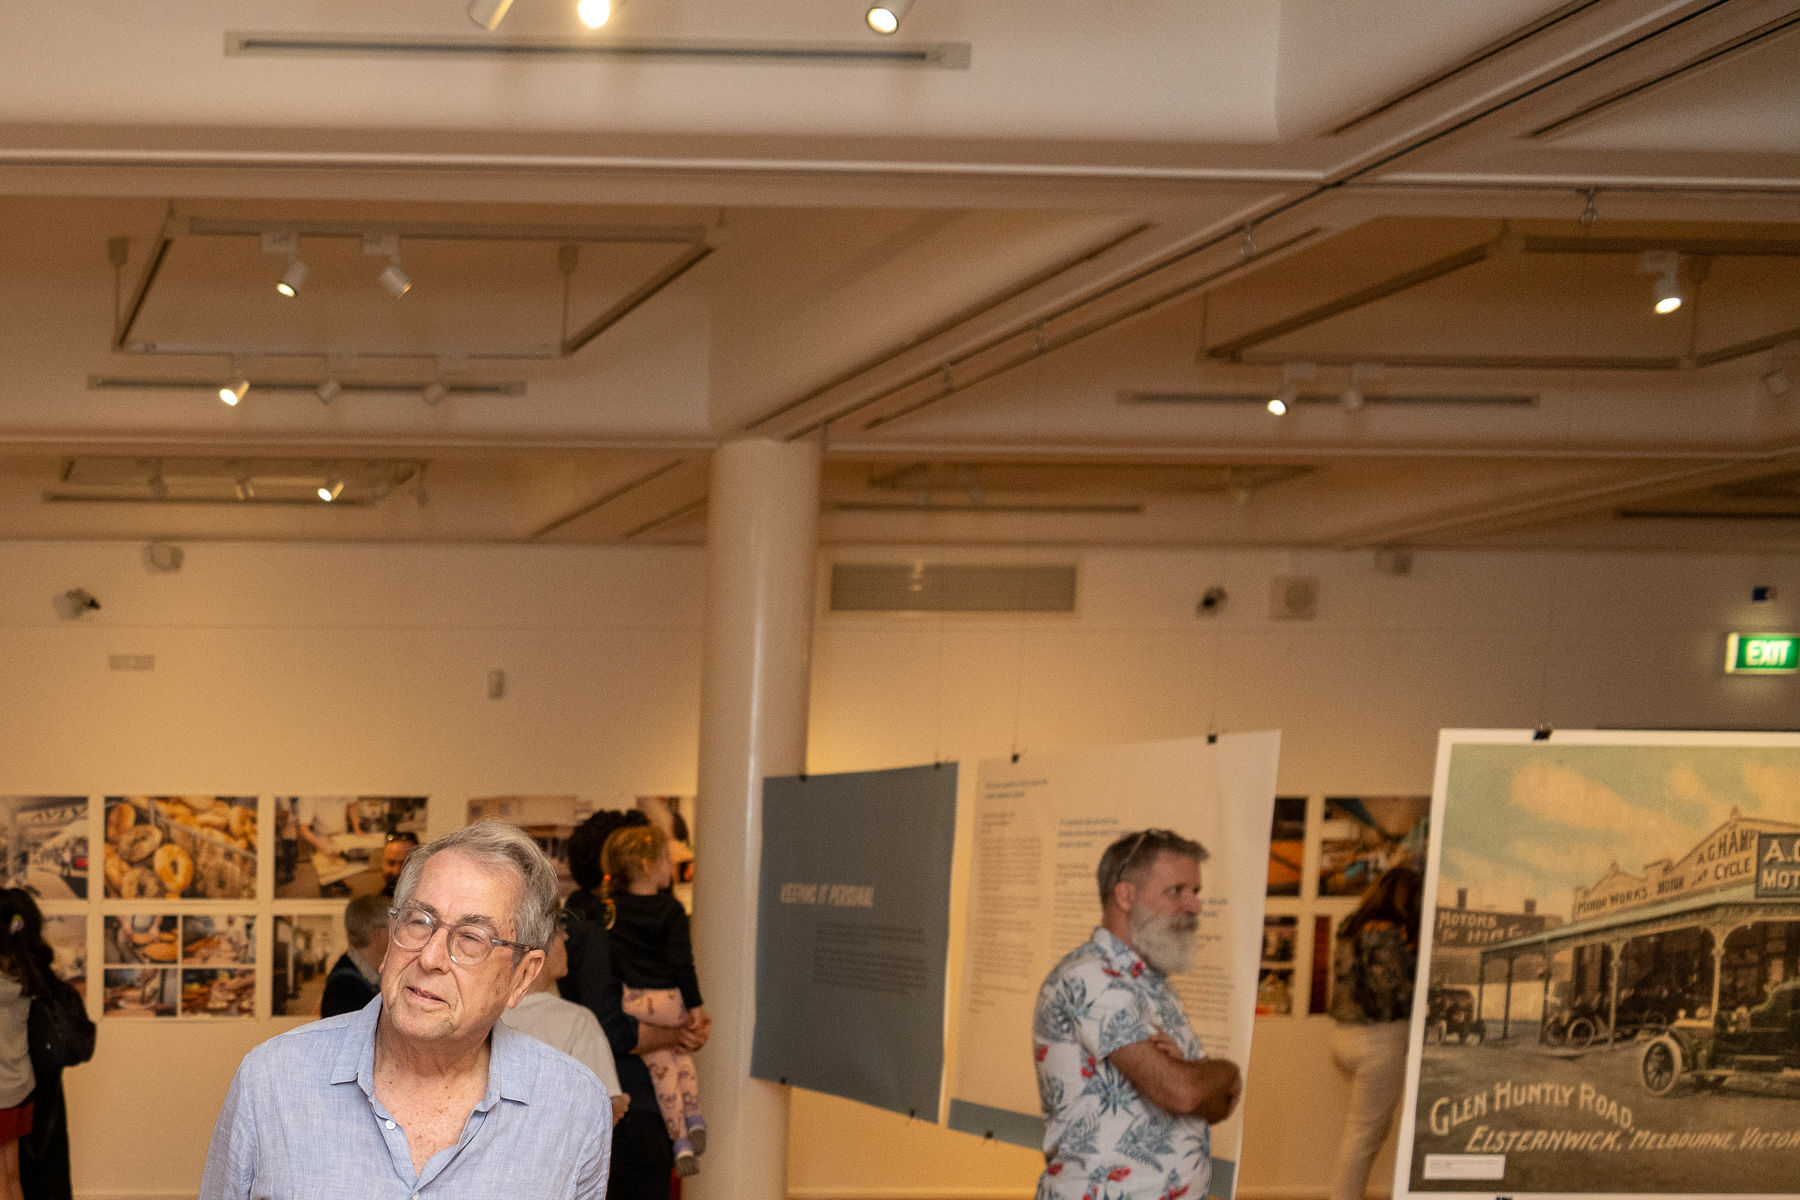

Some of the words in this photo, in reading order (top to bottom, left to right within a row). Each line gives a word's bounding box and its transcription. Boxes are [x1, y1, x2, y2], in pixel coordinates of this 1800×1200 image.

[1745, 639, 1792, 666] EXIT
[1430, 1096, 1488, 1136] GLEN
[1493, 1079, 1575, 1112] HUNTLY
